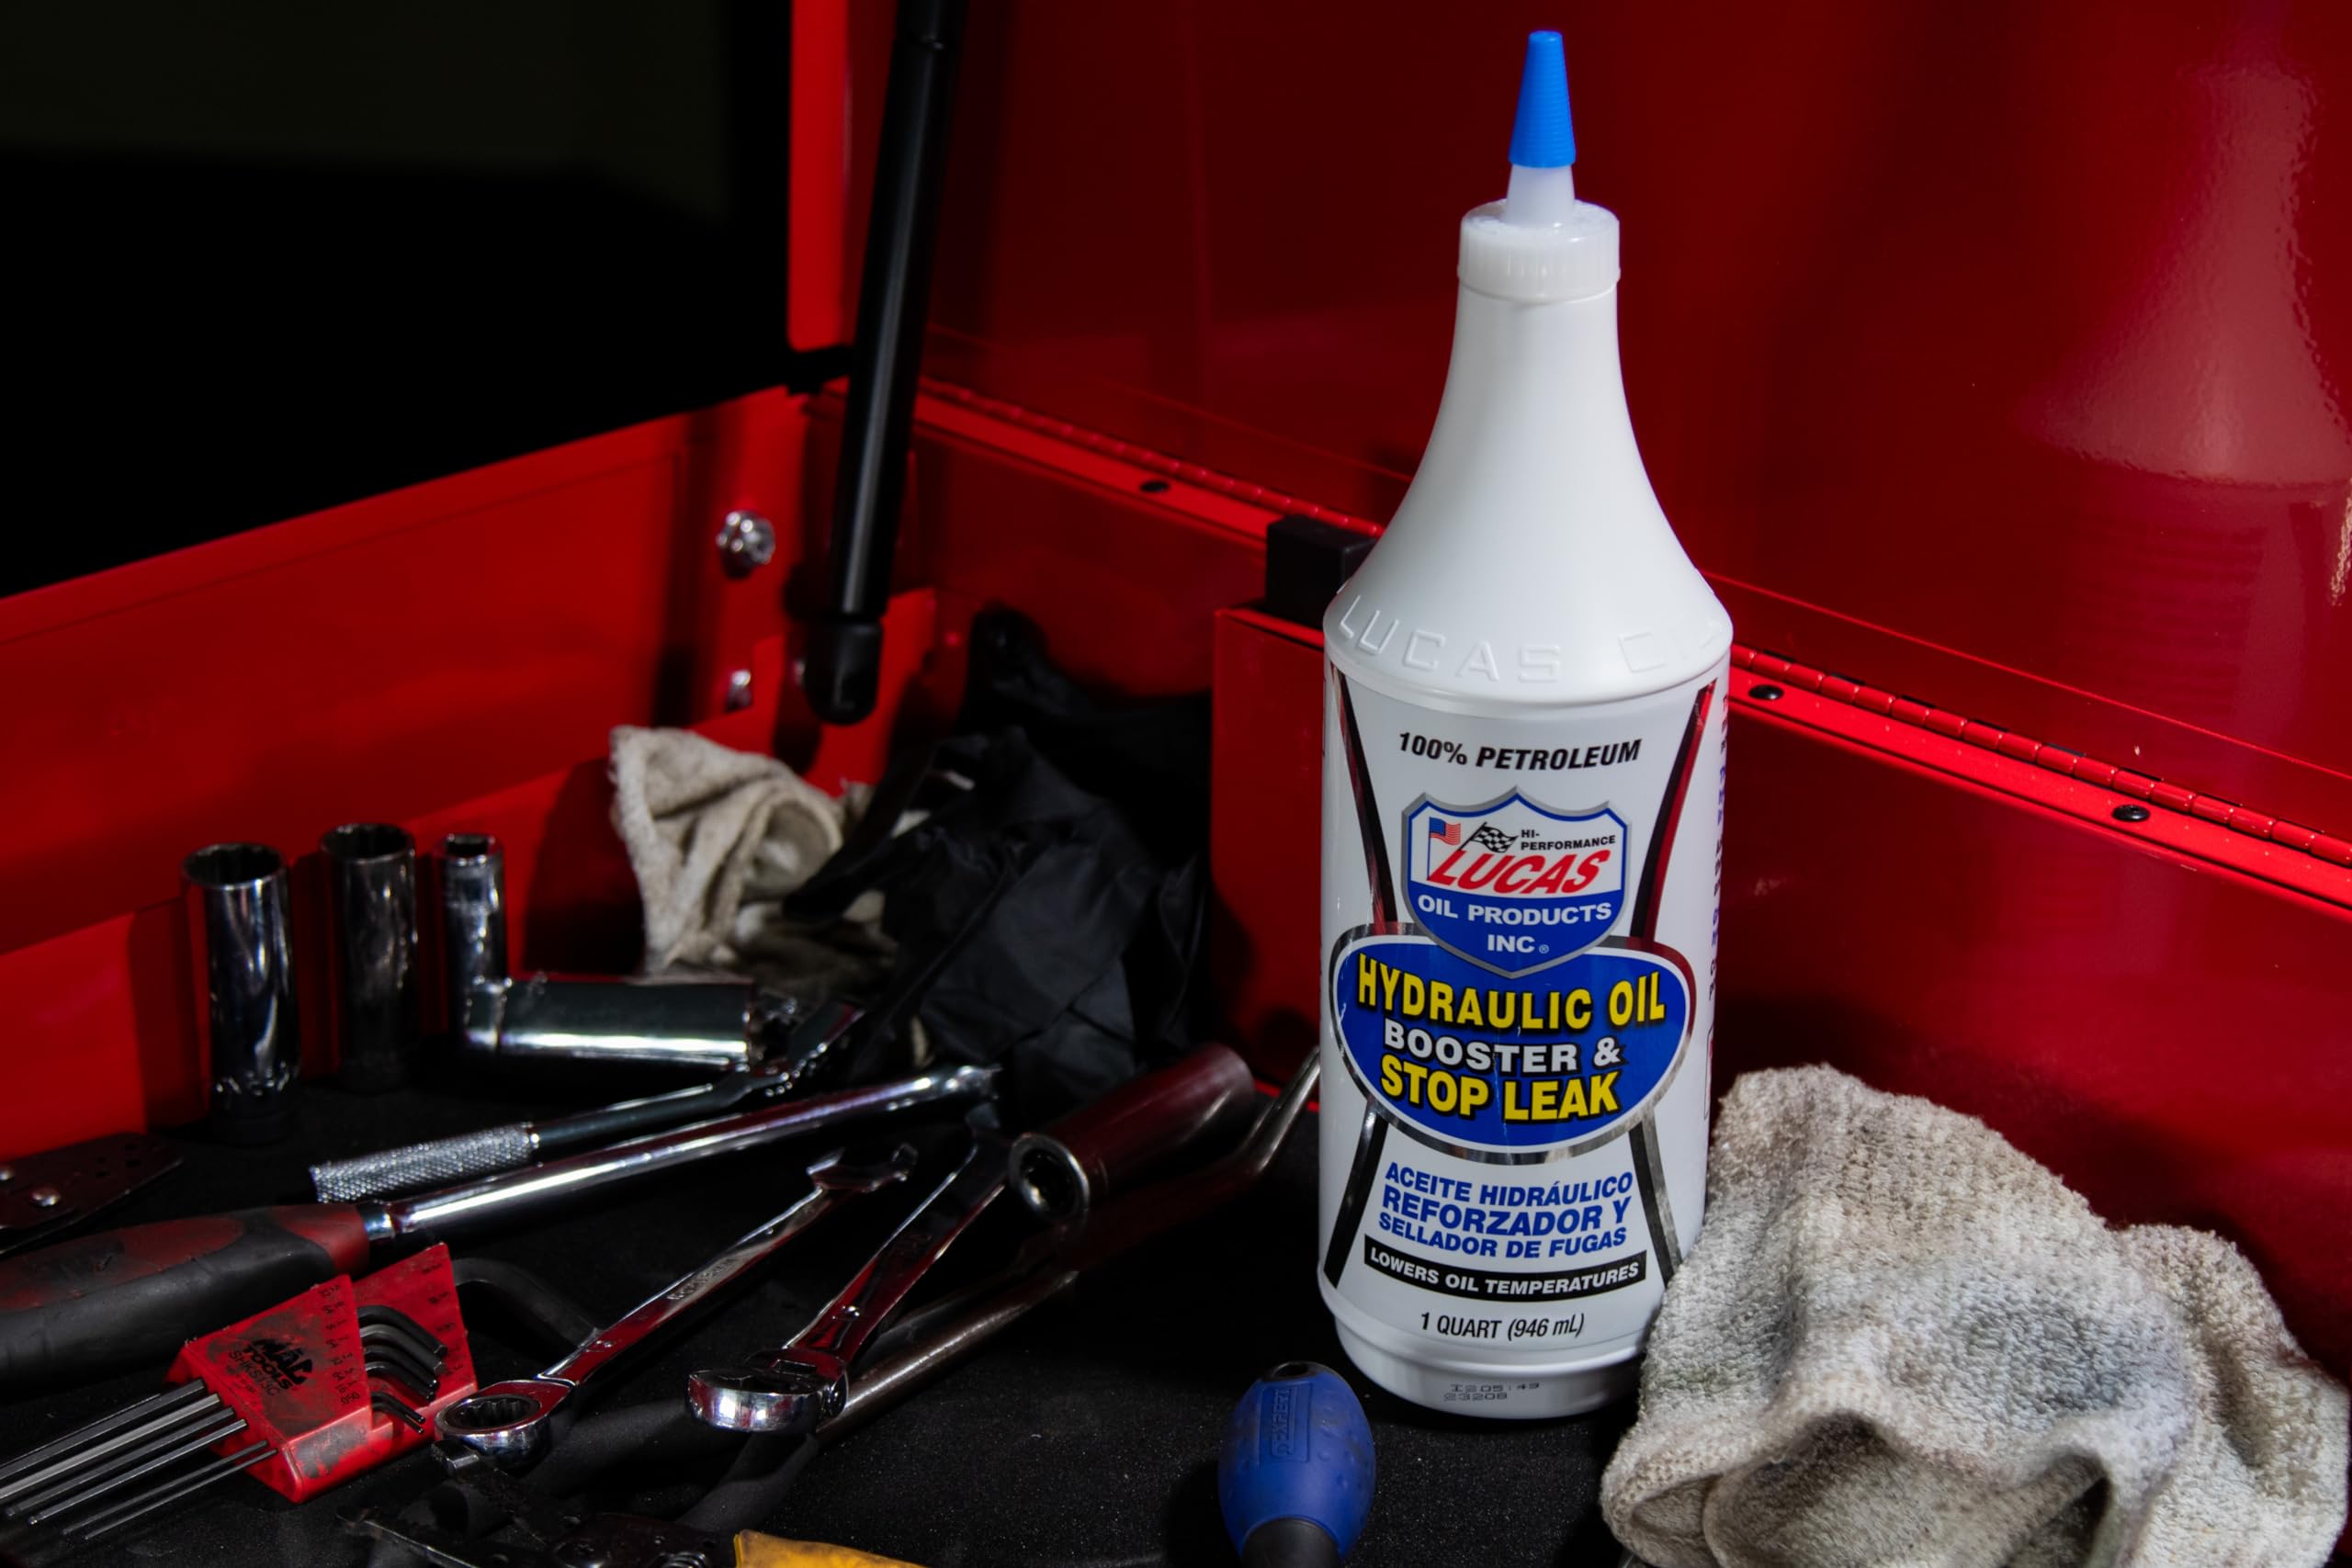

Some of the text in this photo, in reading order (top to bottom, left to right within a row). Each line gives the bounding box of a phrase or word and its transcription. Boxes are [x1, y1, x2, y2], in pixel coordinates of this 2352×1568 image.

[1340, 594, 1560, 682] LUCAS
[1399, 732, 1642, 771] 100% PETROLEUM
[1521, 829, 1540, 838] HI-
[1521, 835, 1616, 851] PERFORMANCE
[1427, 849, 1611, 894] LUCAS
[1418, 895, 1611, 926] OIL PRODUCTS
[1358, 953, 1666, 1031] HYDRAULIC OIL
[1384, 1019, 1621, 1073] BOOSTER &
[1380, 1054, 1619, 1121] STOP LEAK
[1385, 1161, 1633, 1208] ACEITE HIDRÁULICO
[1382, 1185, 1632, 1236] REFORZADOR Y
[1378, 1212, 1627, 1258] SELLADOR DE FUGAS
[1370, 1247, 1640, 1295] LOWERS OIL TEMPERATURES
[1419, 1312, 1585, 1342] 1 QUART (946 mL)
